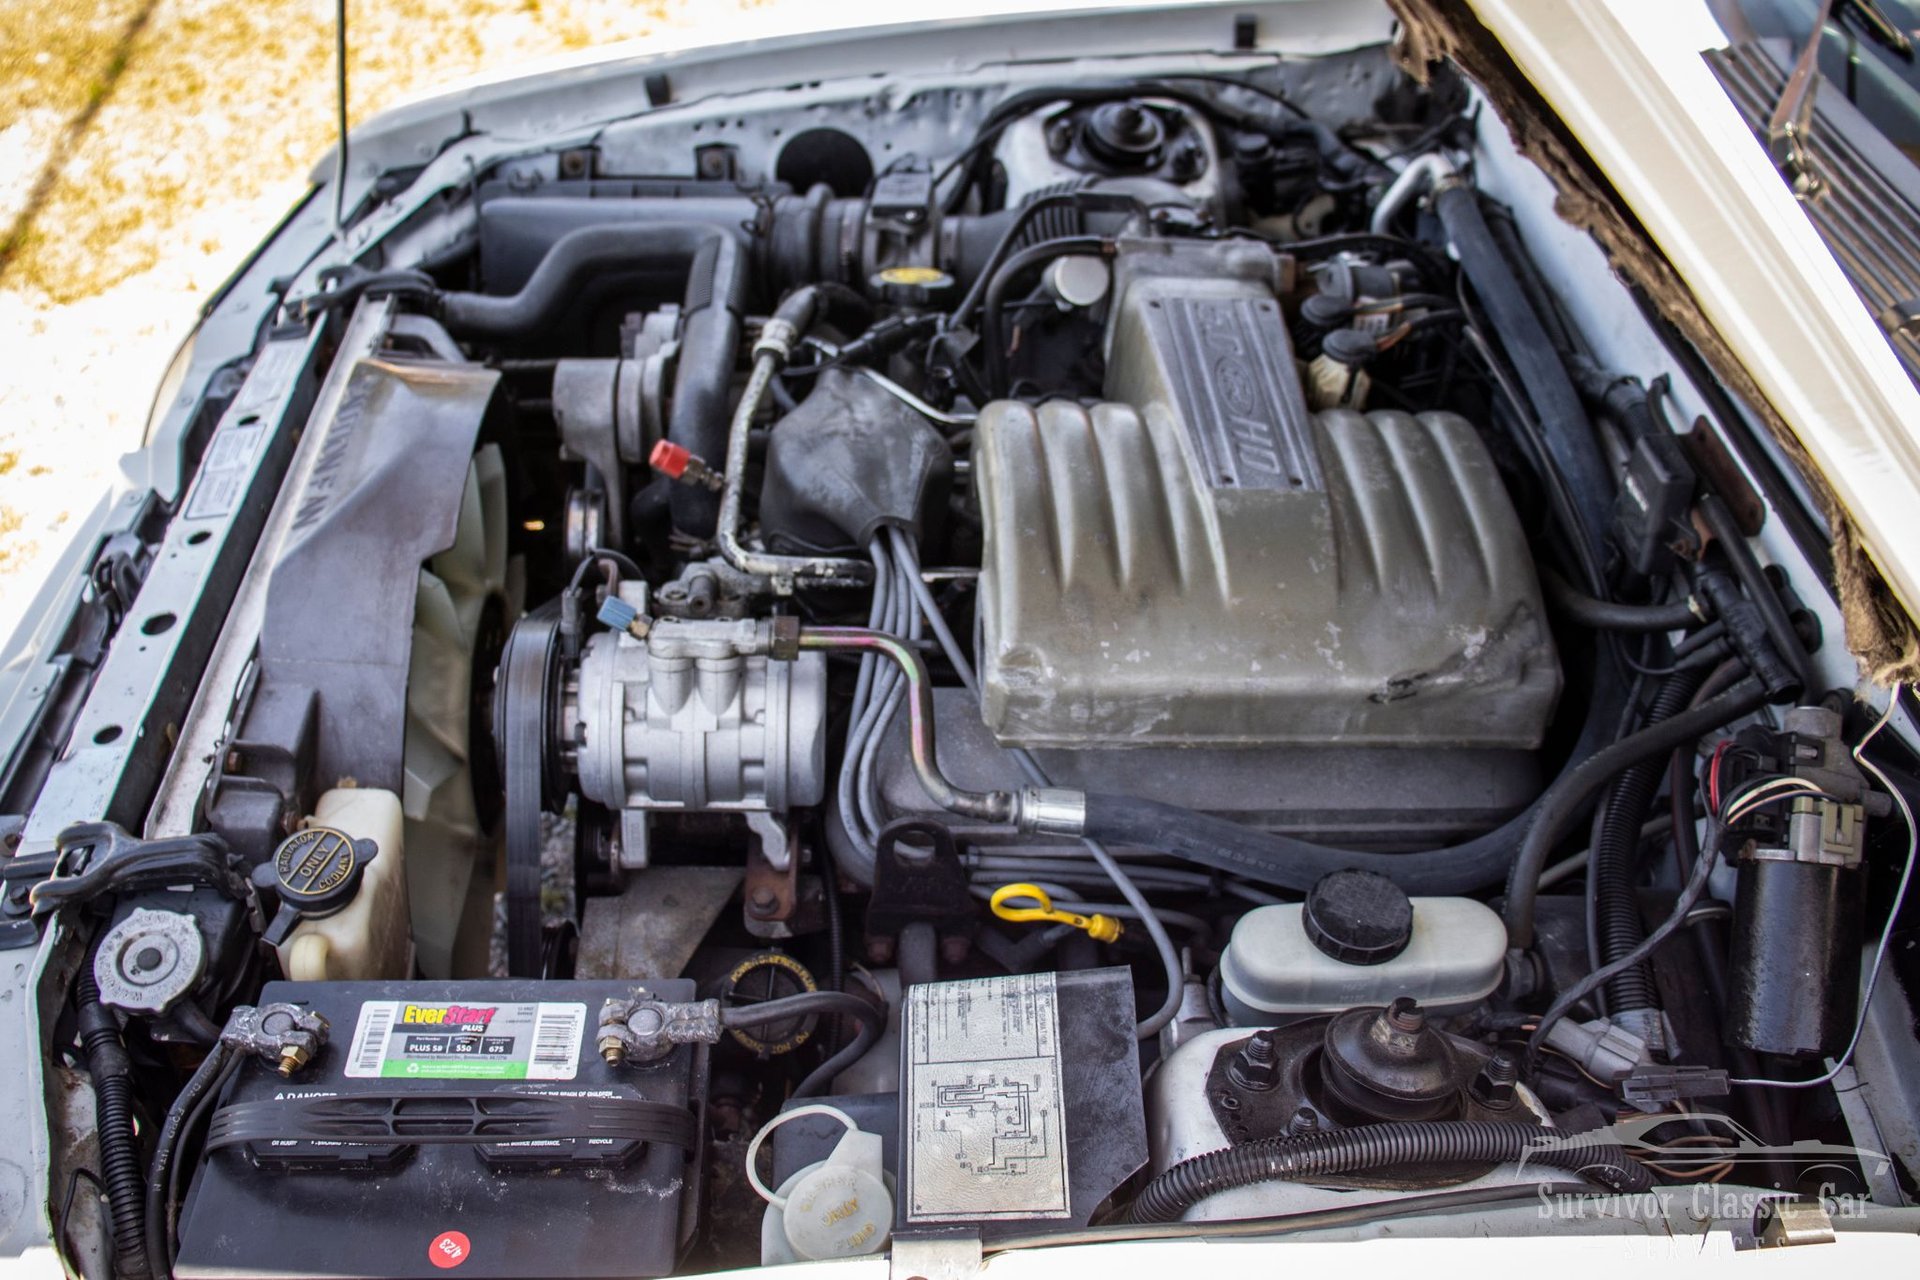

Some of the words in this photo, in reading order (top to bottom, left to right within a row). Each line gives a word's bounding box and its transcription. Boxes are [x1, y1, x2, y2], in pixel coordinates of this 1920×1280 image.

[279, 831, 315, 874] RADIATOR
[300, 844, 329, 878] ONLY
[318, 853, 351, 890] COOLANT
[403, 1004, 496, 1025] EverStart
[461, 1024, 485, 1032] PLUS
[409, 1044, 431, 1052] PLUS
[488, 1045, 505, 1053] 675
[438, 1238, 463, 1259] 4/23
